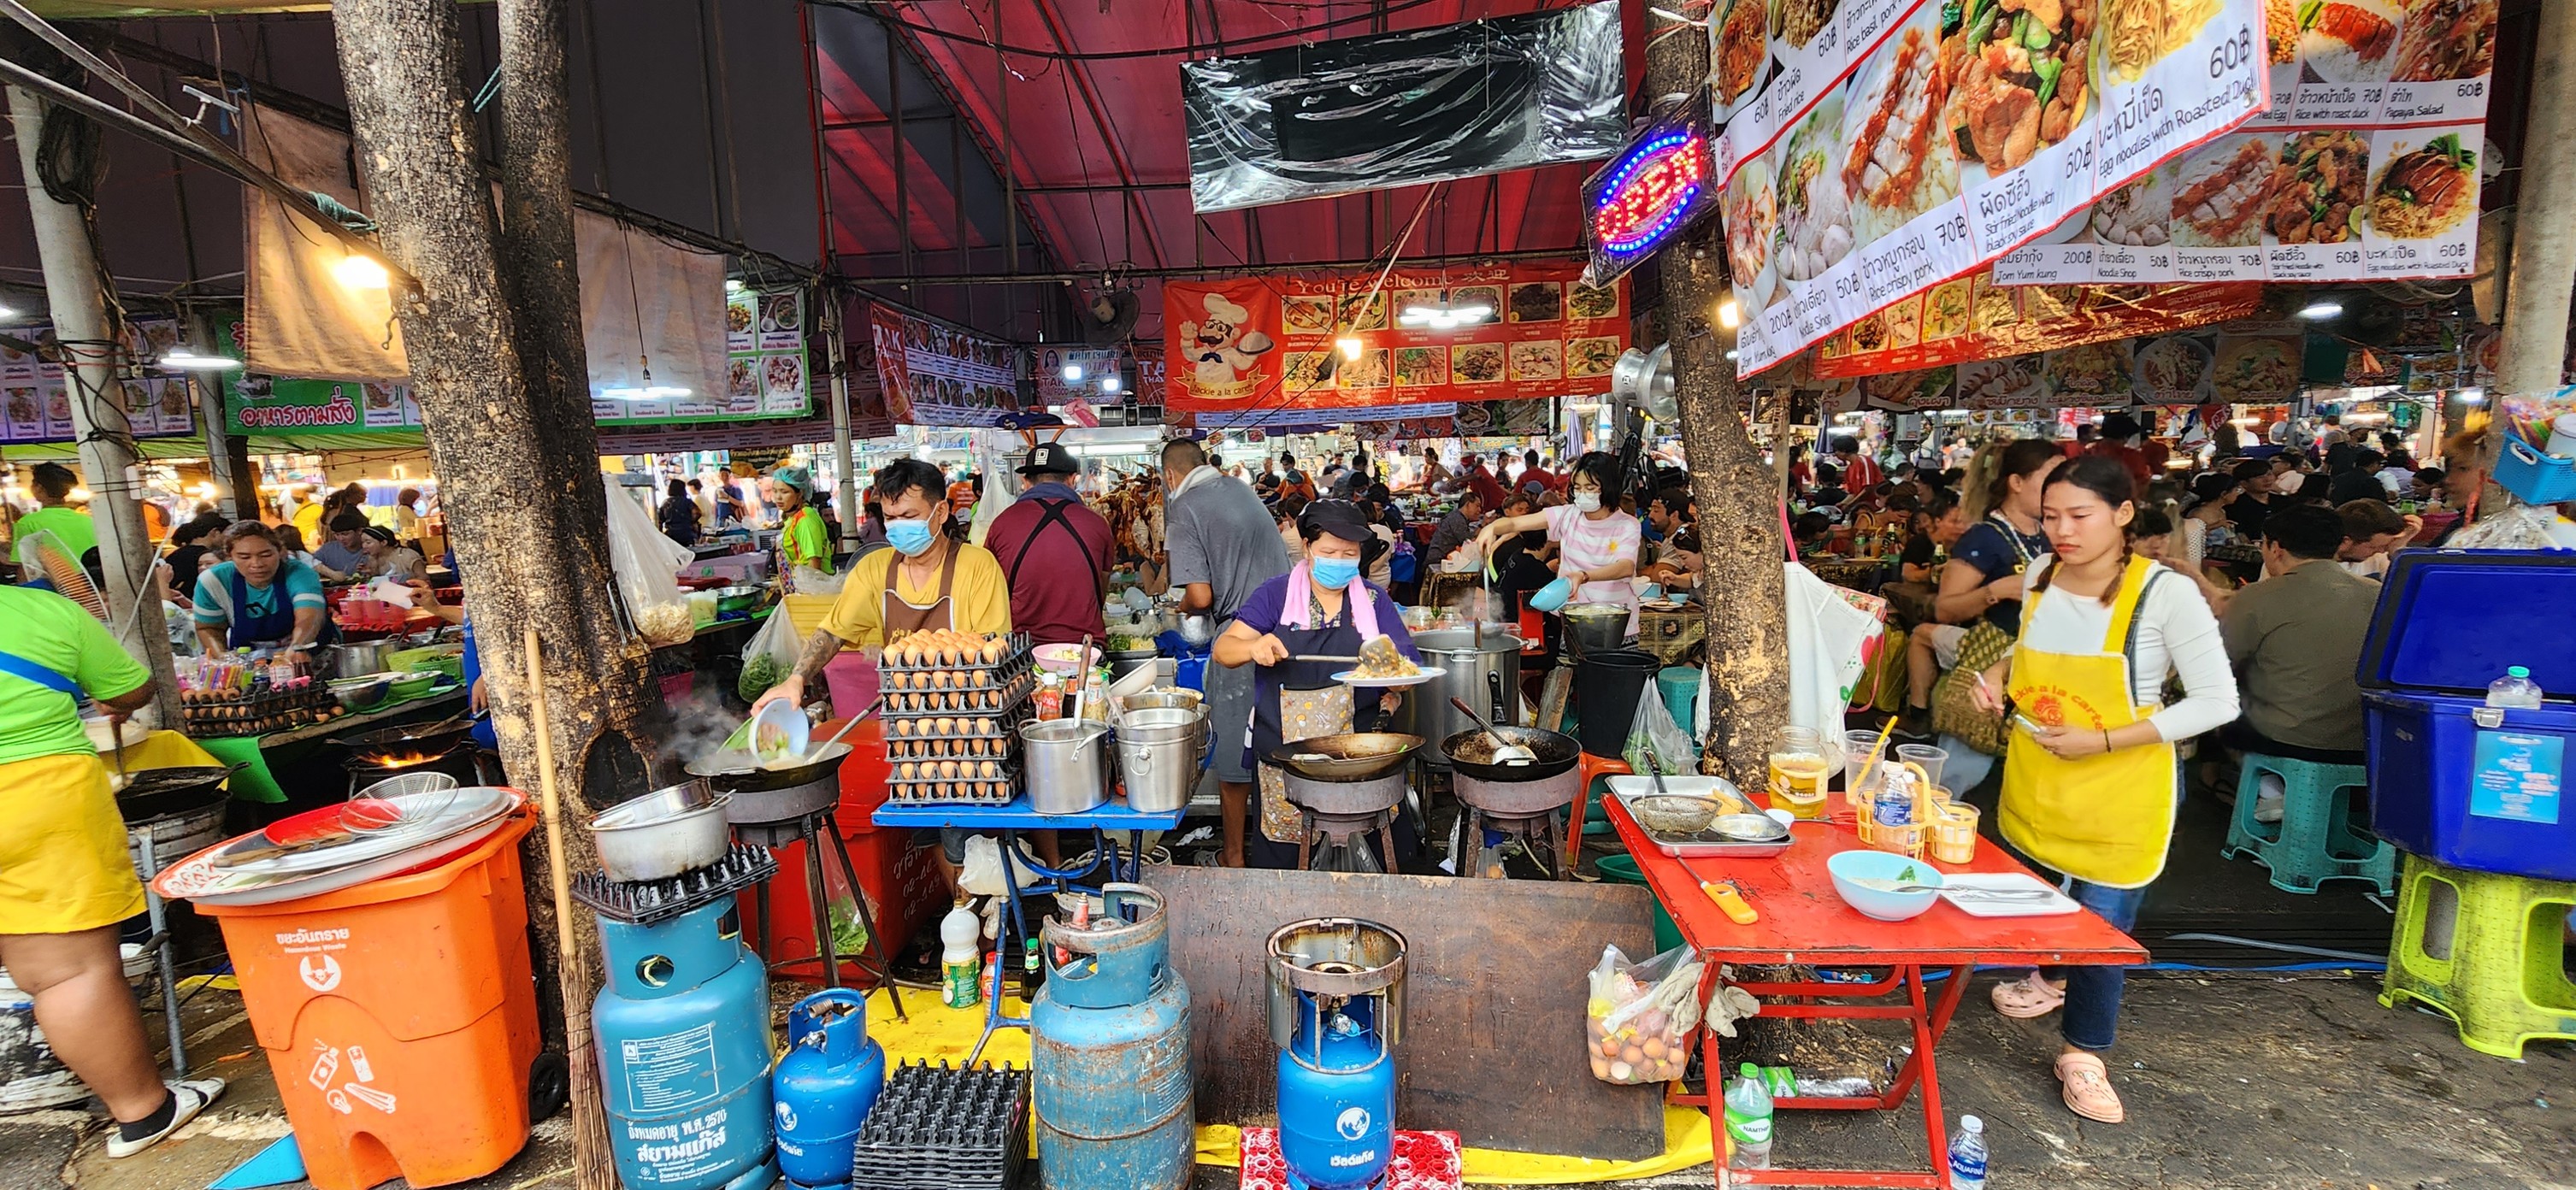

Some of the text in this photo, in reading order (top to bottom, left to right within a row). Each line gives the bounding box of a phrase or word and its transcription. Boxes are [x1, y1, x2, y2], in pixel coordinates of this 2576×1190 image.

[1847, 3, 1897, 55] Rice basil pork
[1818, 26, 1837, 57] 60฿
[2209, 24, 2252, 80] 60฿
[1777, 68, 1801, 101] ข้าวผัด
[2362, 87, 2382, 103] 70฿
[2457, 81, 2484, 98] 60฿
[1778, 102, 1795, 123] Fried
[2416, 103, 2444, 116] Salad
[2099, 158, 2114, 178] Egg
[2115, 134, 2151, 166] noodles
[2152, 115, 2174, 142] with
[2175, 84, 2231, 127] Roasted
[2066, 136, 2093, 180] 60฿
[1598, 137, 1701, 242] OPEN
[1935, 213, 1968, 247] 70฿
[1862, 233, 1926, 280] ข้าวหมูกรอบ
[2063, 250, 2092, 265] 200฿
[2178, 250, 2231, 268] ข้าวหมูกรอบ
[2237, 253, 2262, 267] 70฿
[2336, 250, 2360, 264] 60฿
[2439, 243, 2467, 258] 60฿
[2150, 255, 2169, 268] 50฿
[1460, 269, 1511, 283] 欢迎
[1868, 260, 1936, 303] Rice crispy pork
[2017, 269, 2034, 280] Yum
[2036, 268, 2058, 281] kung
[1836, 273, 1860, 299] 50฿
[1769, 308, 1793, 335] 200฿
[1041, 377, 1066, 387] TAK
[1191, 384, 1216, 396] Jackie
[239, 386, 357, 427] อาหารตามสั่ง
[2052, 685, 2066, 698] la
[2071, 695, 2105, 730] carte
[628, 1121, 680, 1142] ถังหมดอายุ
[636, 1126, 727, 1163] สยามแก๊ส
[1952, 1159, 1984, 1176] AQUAFINA
